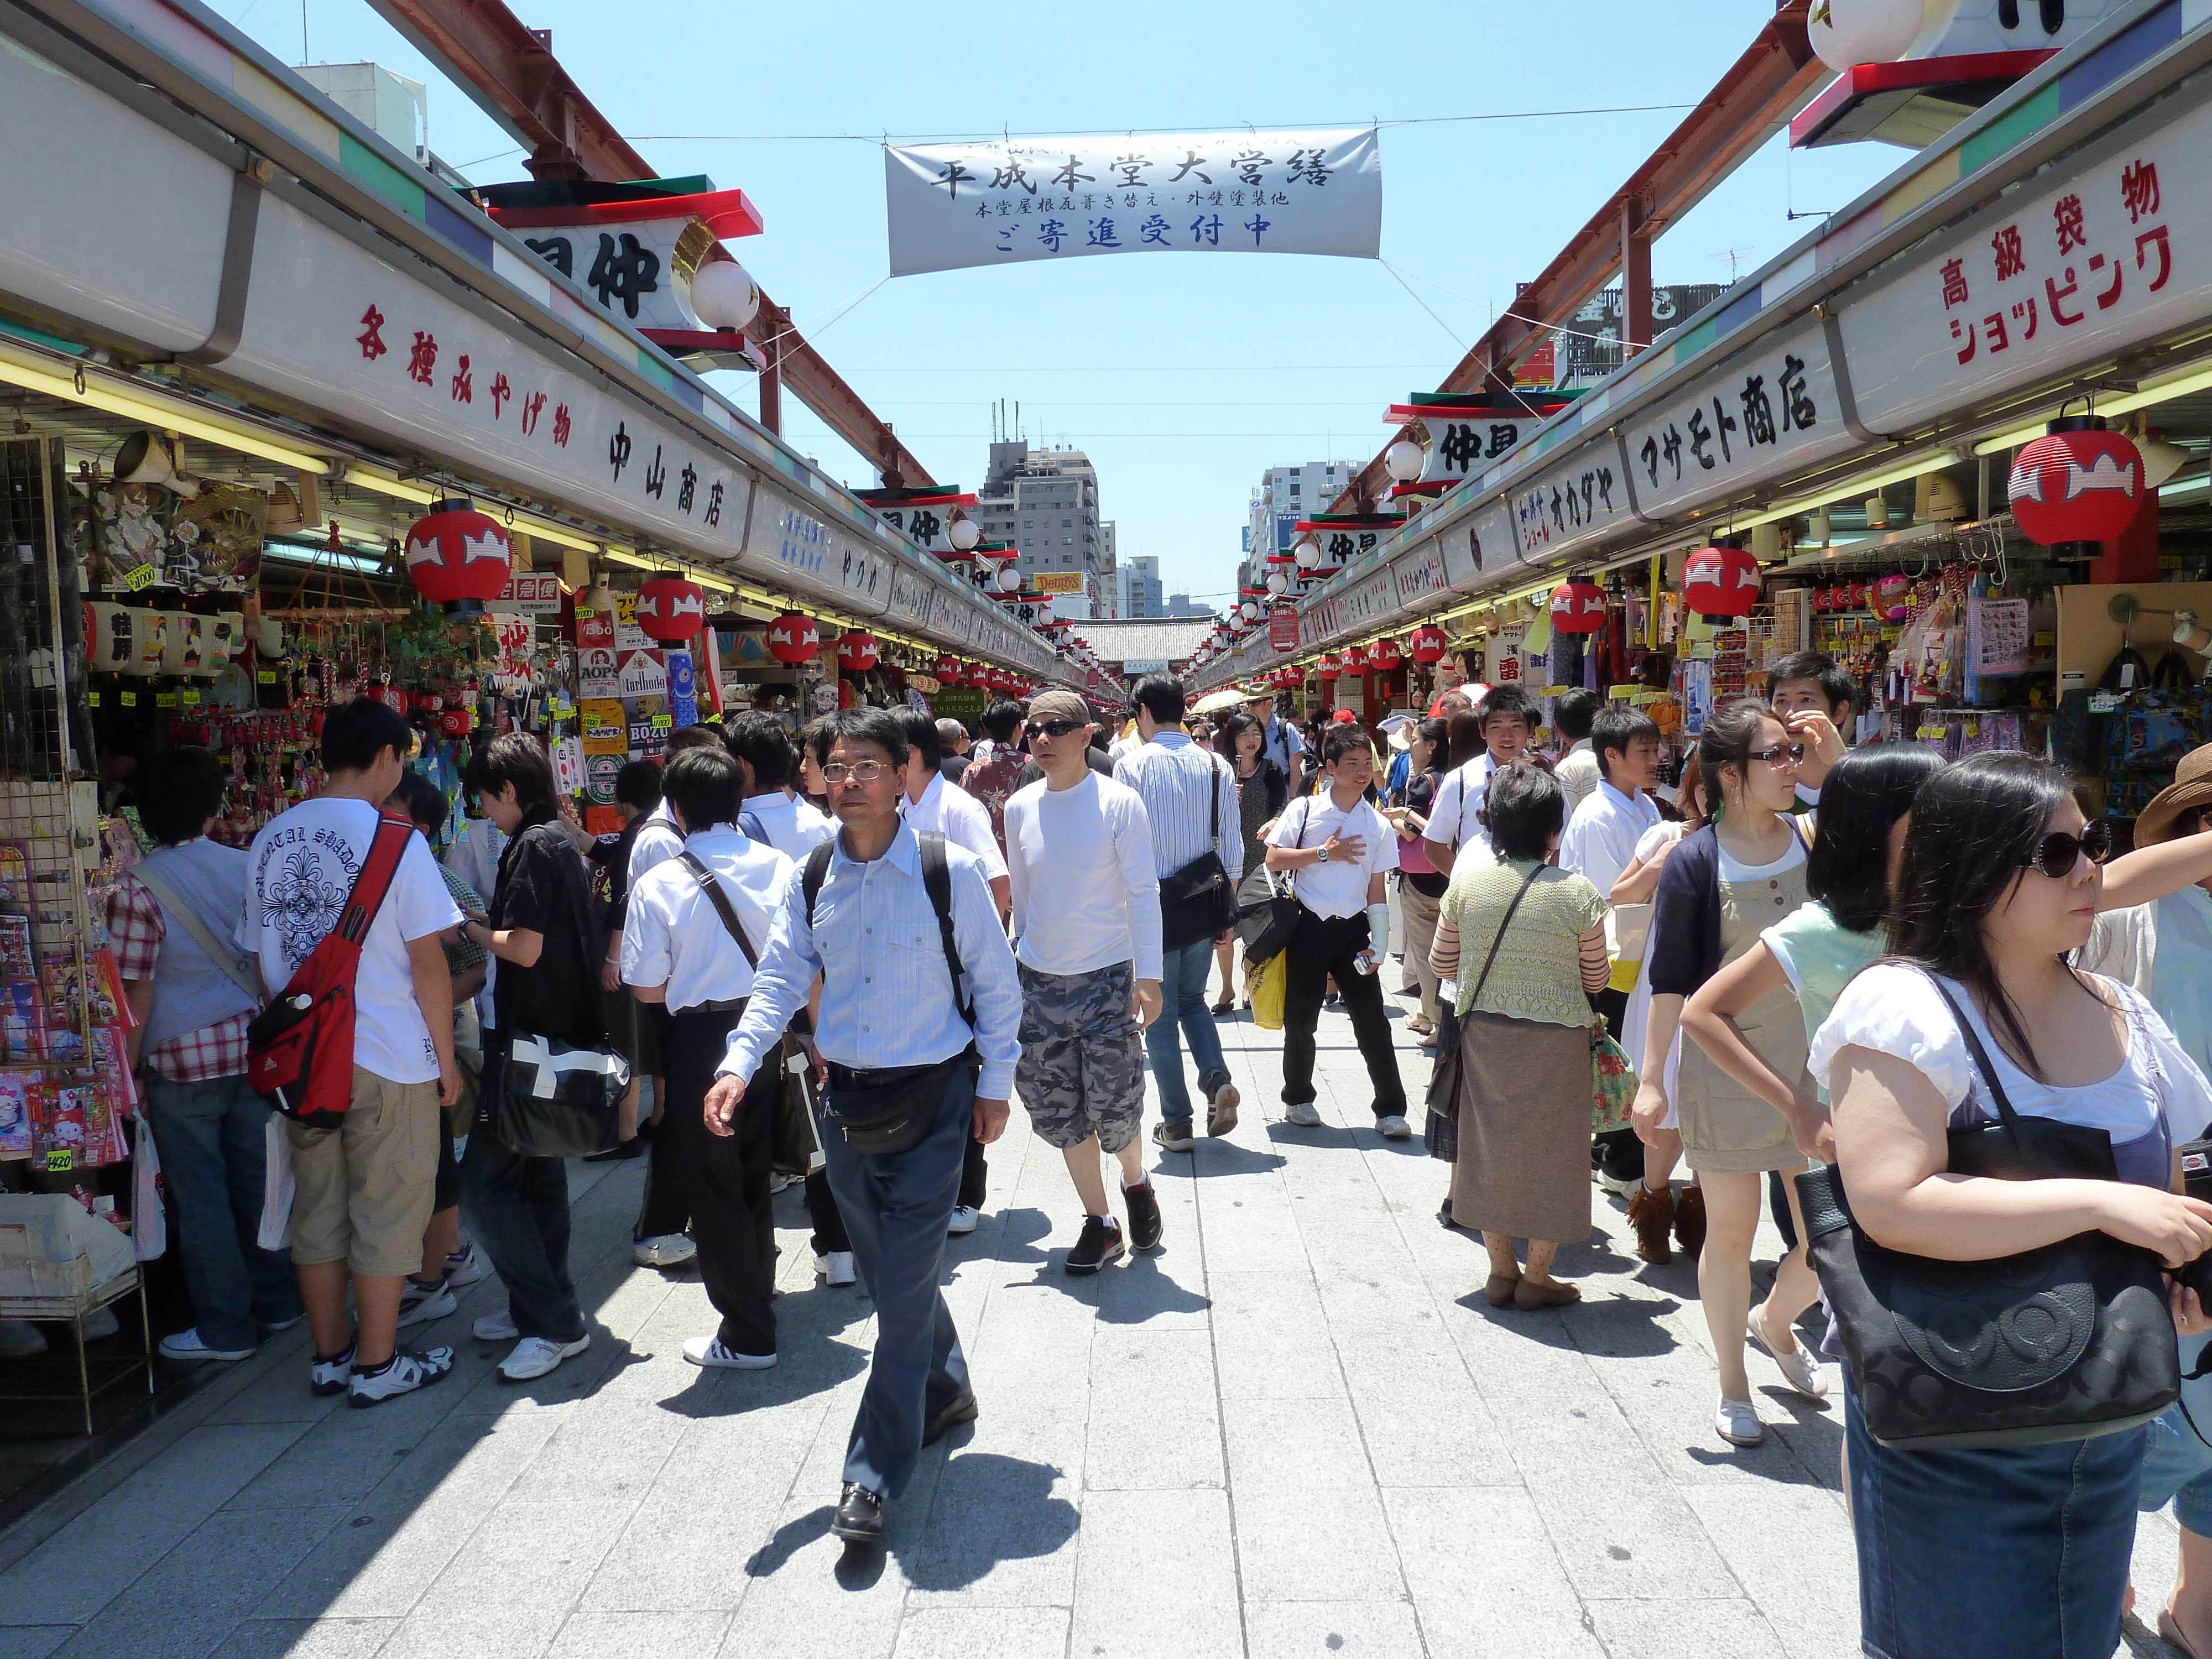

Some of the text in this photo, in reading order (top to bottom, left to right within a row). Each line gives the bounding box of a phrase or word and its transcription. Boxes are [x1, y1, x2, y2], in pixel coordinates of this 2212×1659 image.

[930, 147, 1334, 200] 平成本堂大営繕
[975, 189, 1290, 218] 本堂屋根瓦葺き替え・外壁塗装他
[996, 213, 1271, 253] ご寄進受付中
[1939, 159, 2161, 310] 高級袋物
[356, 304, 571, 448] 各種みやげ物
[1641, 354, 1817, 488] マサモト商店
[610, 421, 723, 528] 中山商店
[1550, 467, 1613, 533] オカダヤ
[1524, 518, 1550, 551] ショール
[842, 549, 877, 596] やつめ
[1037, 574, 1079, 591] Denny's
[586, 623, 613, 635] Boo
[1499, 657, 1519, 681] 雷
[631, 727, 669, 740] BOZU
